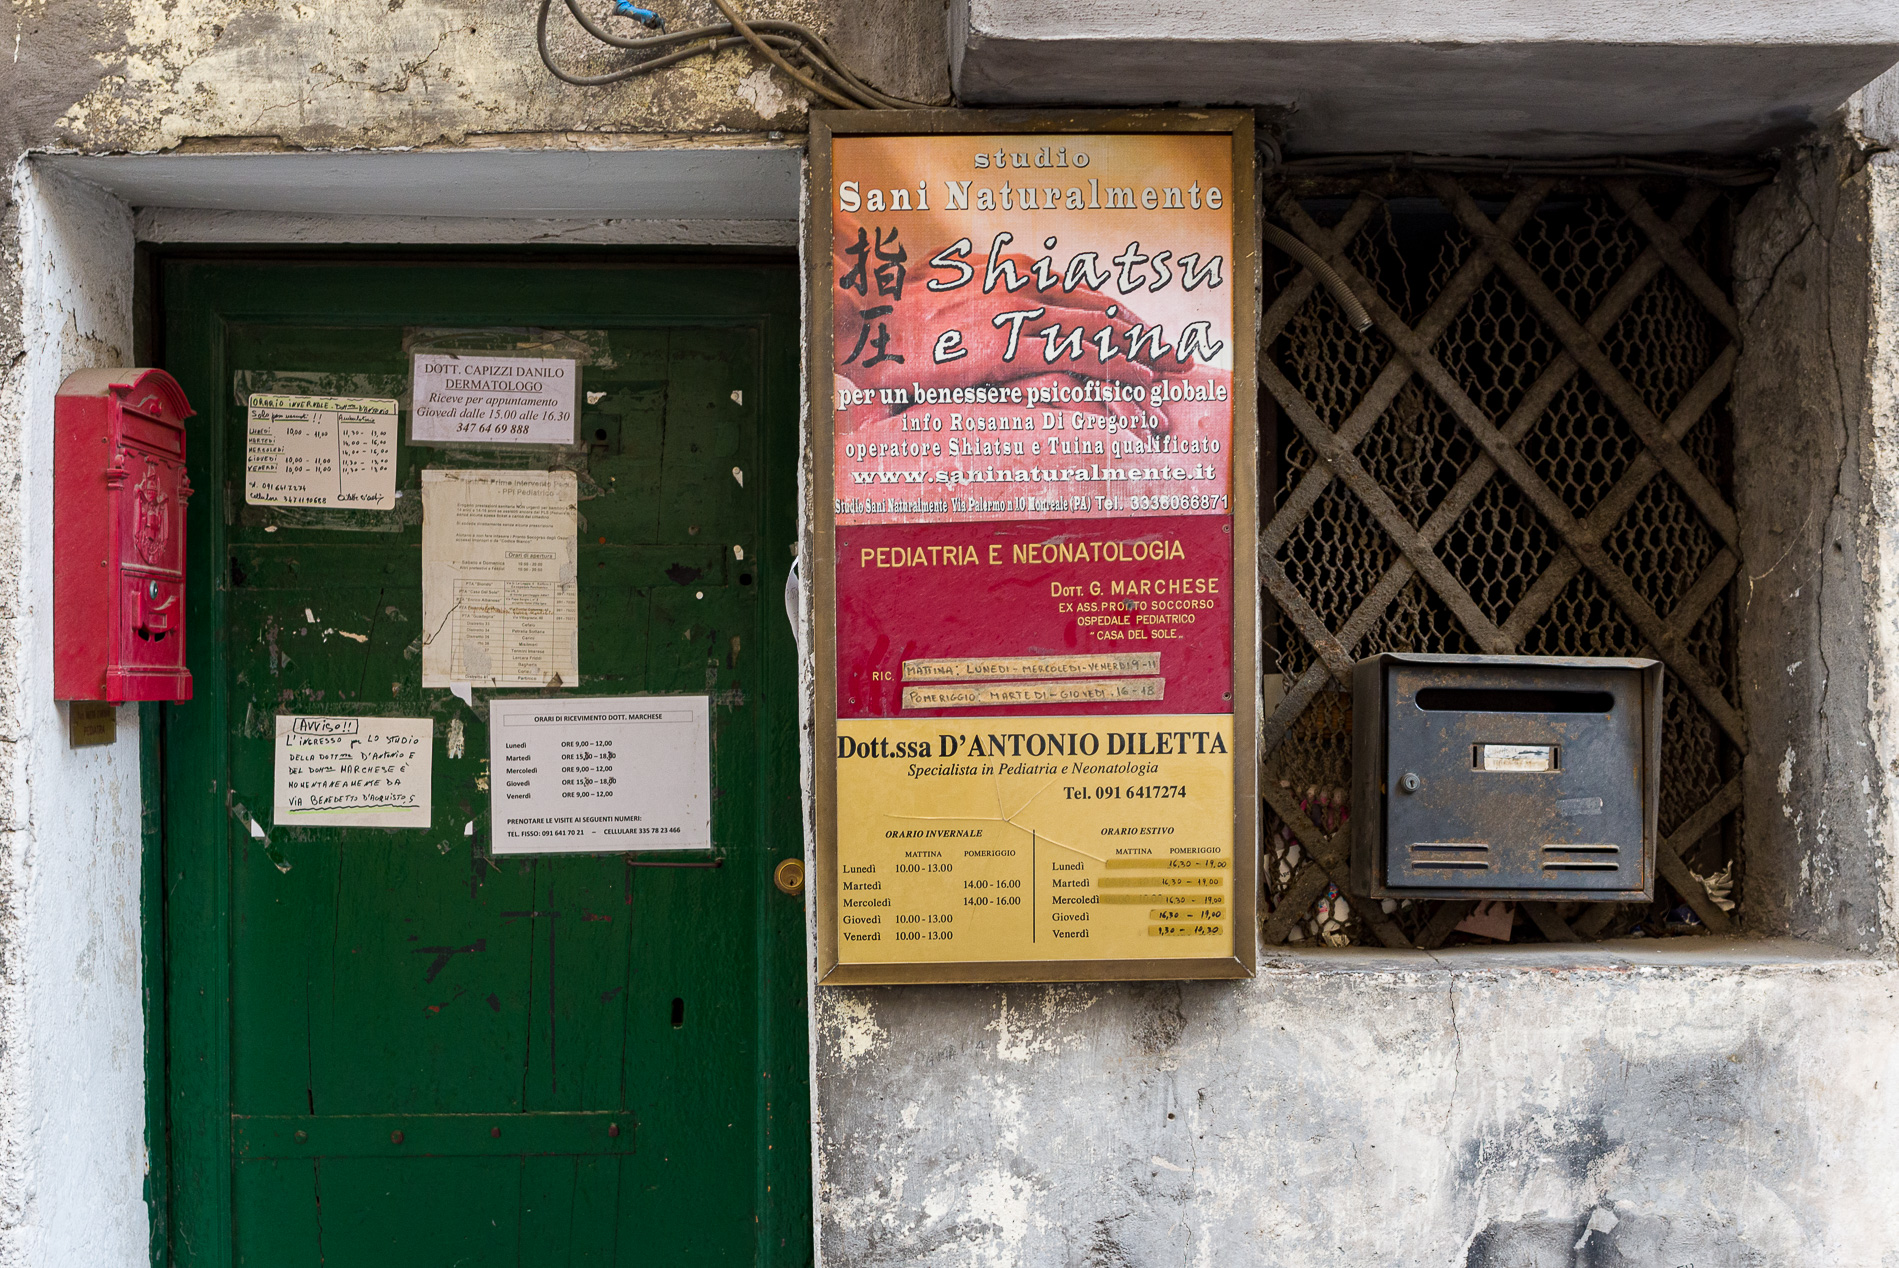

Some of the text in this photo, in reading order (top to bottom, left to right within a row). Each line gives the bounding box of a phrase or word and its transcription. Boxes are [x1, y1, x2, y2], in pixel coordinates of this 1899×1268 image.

[974, 146, 1090, 168] studio
[839, 178, 1223, 213] Sani Naturalmente
[926, 231, 1223, 295] Shiatsu
[933, 305, 1223, 363] e Tuina
[425, 363, 564, 378] DOTT. CAPIZZI DANILO
[446, 378, 543, 392] DERMATOLOGO
[429, 392, 558, 409] Riceve per appuntamento
[837, 379, 1228, 411] per un benessere psicofisico globale
[417, 406, 570, 421] Giovedì dalle 15.00 alle 16.30
[456, 422, 530, 434] 347 64 69 888
[902, 410, 1159, 434] info Rosanna Di Gregorio
[845, 434, 1220, 462] operatore Shiatsu e Tuina qualificato
[851, 463, 1216, 484] www.saninaturalmente.it
[835, 498, 864, 514] Studio
[865, 498, 886, 514] Sani
[887, 497, 949, 514] Naturalmente
[951, 497, 967, 512] Via
[968, 497, 1005, 513] Palermo
[1070, 496, 1091, 513] (PA)
[1095, 496, 1123, 511] Tel.
[1130, 494, 1229, 511] 3336066871
[860, 540, 1185, 568] PEDIATRIA E NEONATOLOGIA
[1090, 581, 1104, 596] G.
[1111, 578, 1219, 596] MARCHESE
[1059, 602, 1074, 613] EX
[1151, 600, 1214, 610] SOCCORSO
[1077, 614, 1195, 626] OSPEDALE PEDIATRICO
[1128, 630, 1148, 640] DEL
[872, 671, 895, 681] RIC.
[837, 731, 1228, 758] Dott.ssa D'ANTONIO DILETTA
[908, 761, 1158, 779] Specialista in Pediatria e Neonatologia
[1064, 785, 1187, 800] Tel. 091 6417274
[885, 829, 983, 838] ORARIO INVERNALE
[1101, 827, 1175, 836] ORARIO ESTIVO
[842, 864, 953, 874] Lunedì 10.00 13.00
[1052, 862, 1084, 871] Lunedì
[842, 880, 1021, 890] Martedì 14.00 16.00
[1052, 878, 1090, 888] Martedì
[842, 896, 1021, 907] Mercoledì 14.00 16.00
[1052, 896, 1100, 904] Mercoledì
[842, 914, 953, 924] Giovedì 10.00 13.00
[1052, 912, 1090, 921] Giovedì
[842, 931, 953, 941] Venerdì 10.00 13.00
[1052, 929, 1090, 938] Venerdì
